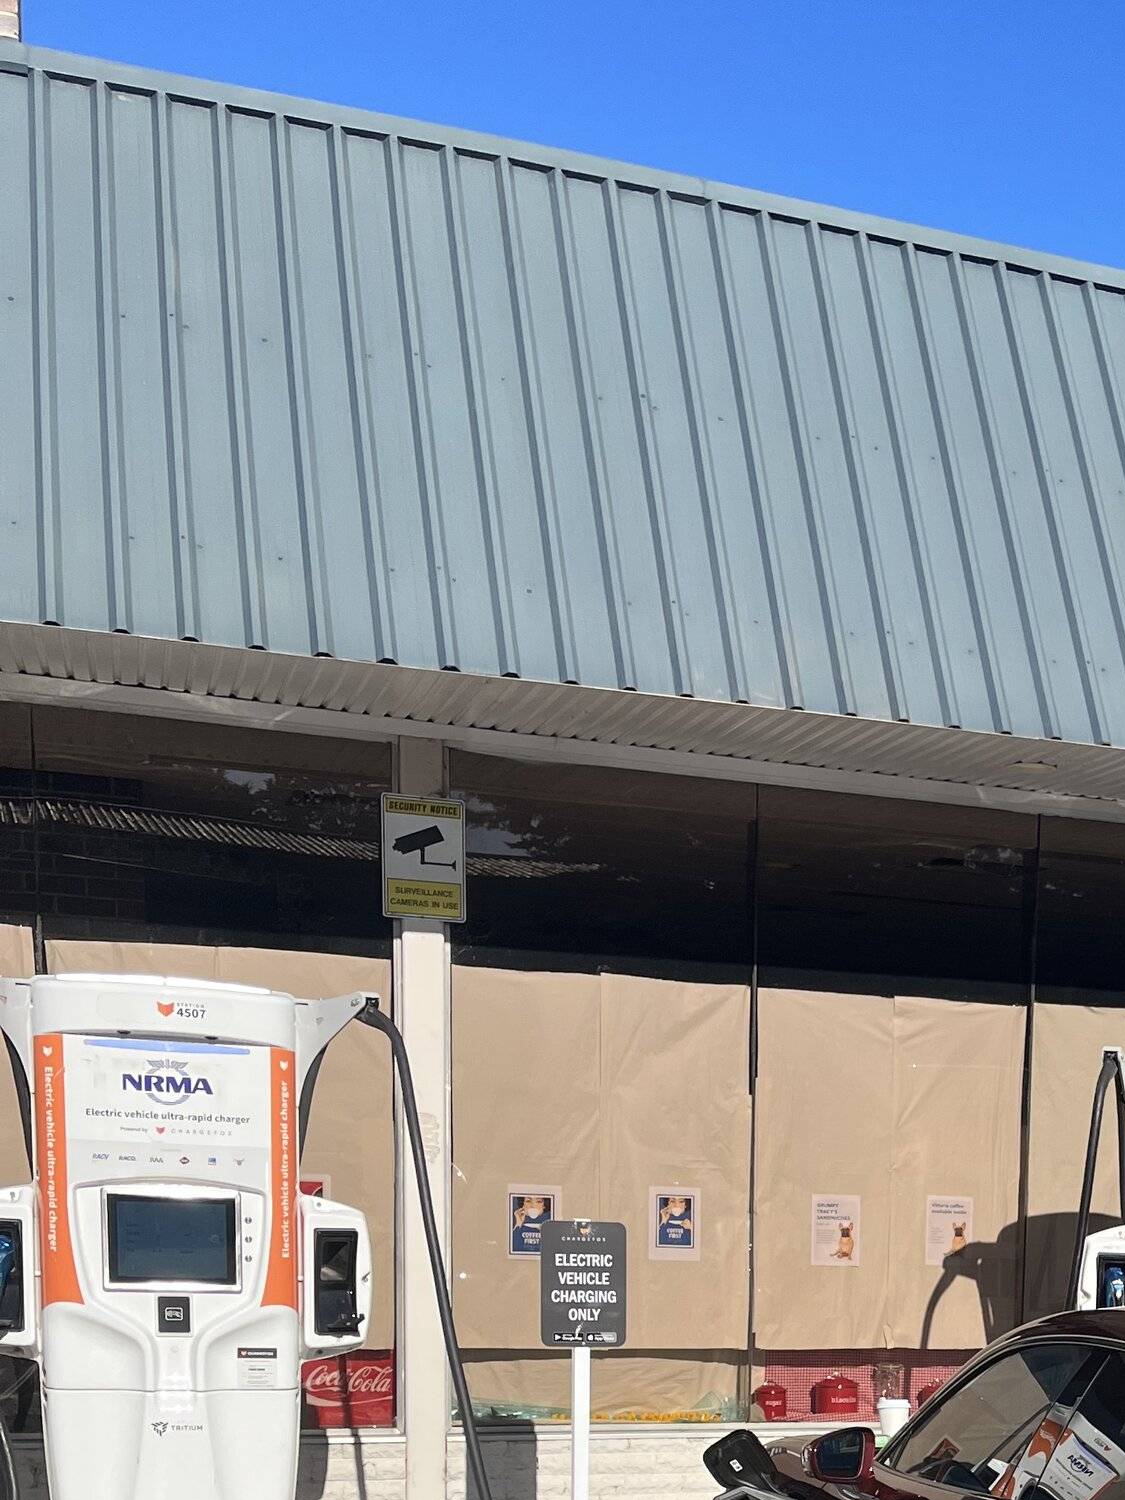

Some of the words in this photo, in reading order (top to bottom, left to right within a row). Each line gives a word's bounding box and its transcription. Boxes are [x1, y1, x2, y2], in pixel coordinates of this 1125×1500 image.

[389, 801, 427, 813] SECURITY
[430, 804, 458, 816] NOTICE
[395, 886, 453, 897] SURVEILLANCE
[390, 898, 429, 908] CAMERAS
[442, 901, 459, 910] USE
[176, 1008, 206, 1019] 4507
[44, 1066, 53, 1107] Electric
[122, 1073, 213, 1095] NRMA
[280, 1081, 289, 1121] charger
[85, 1108, 122, 1118] Electric
[124, 1110, 159, 1120] vehicle
[161, 1112, 212, 1123] ultra-rapid
[214, 1114, 251, 1125] charger
[46, 1109, 55, 1149] vehicle
[280, 1122, 289, 1177] ultra-rapid
[47, 1150, 57, 1209] ultra-rapid
[281, 1179, 289, 1216] vehicle
[48, 1210, 57, 1252] charger
[281, 1217, 289, 1258] Electric
[555, 1253, 613, 1267] ELECTRIC
[558, 1272, 610, 1285] VEHICLE
[551, 1290, 617, 1303] CHARGING
[568, 1308, 601, 1321] ONLY
